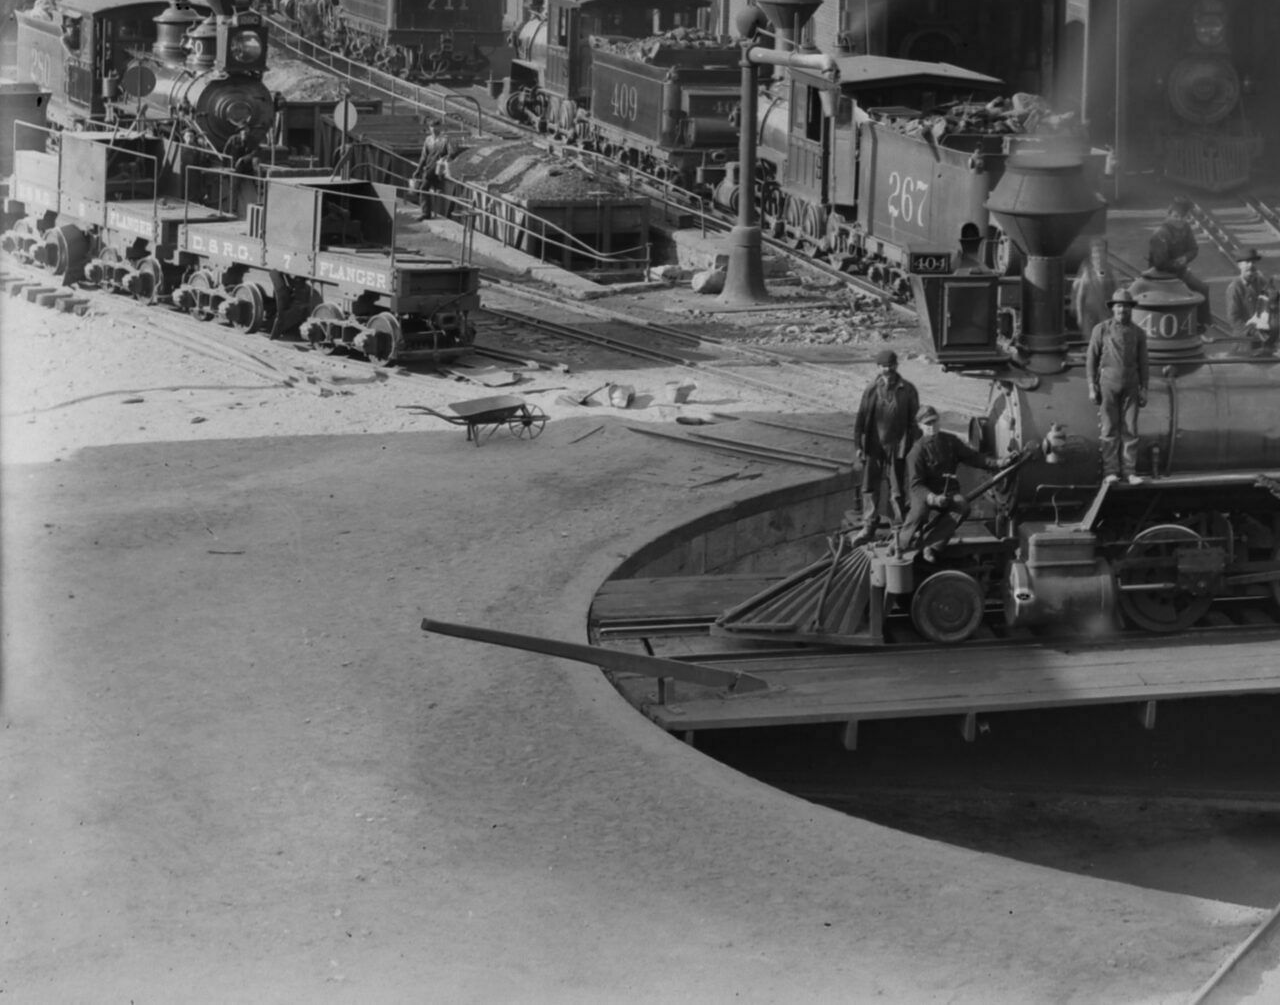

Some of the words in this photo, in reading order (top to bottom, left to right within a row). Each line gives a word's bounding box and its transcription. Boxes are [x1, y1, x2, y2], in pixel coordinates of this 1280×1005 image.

[611, 83, 638, 121] 409
[888, 172, 929, 228] 267
[110, 210, 153, 237] FLANGER
[193, 236, 206, 251] D.
[208, 239, 219, 254] &
[283, 254, 292, 270] 7
[320, 261, 387, 289] FLANGER
[913, 256, 947, 272] 404
[1136, 312, 1194, 339] 404
